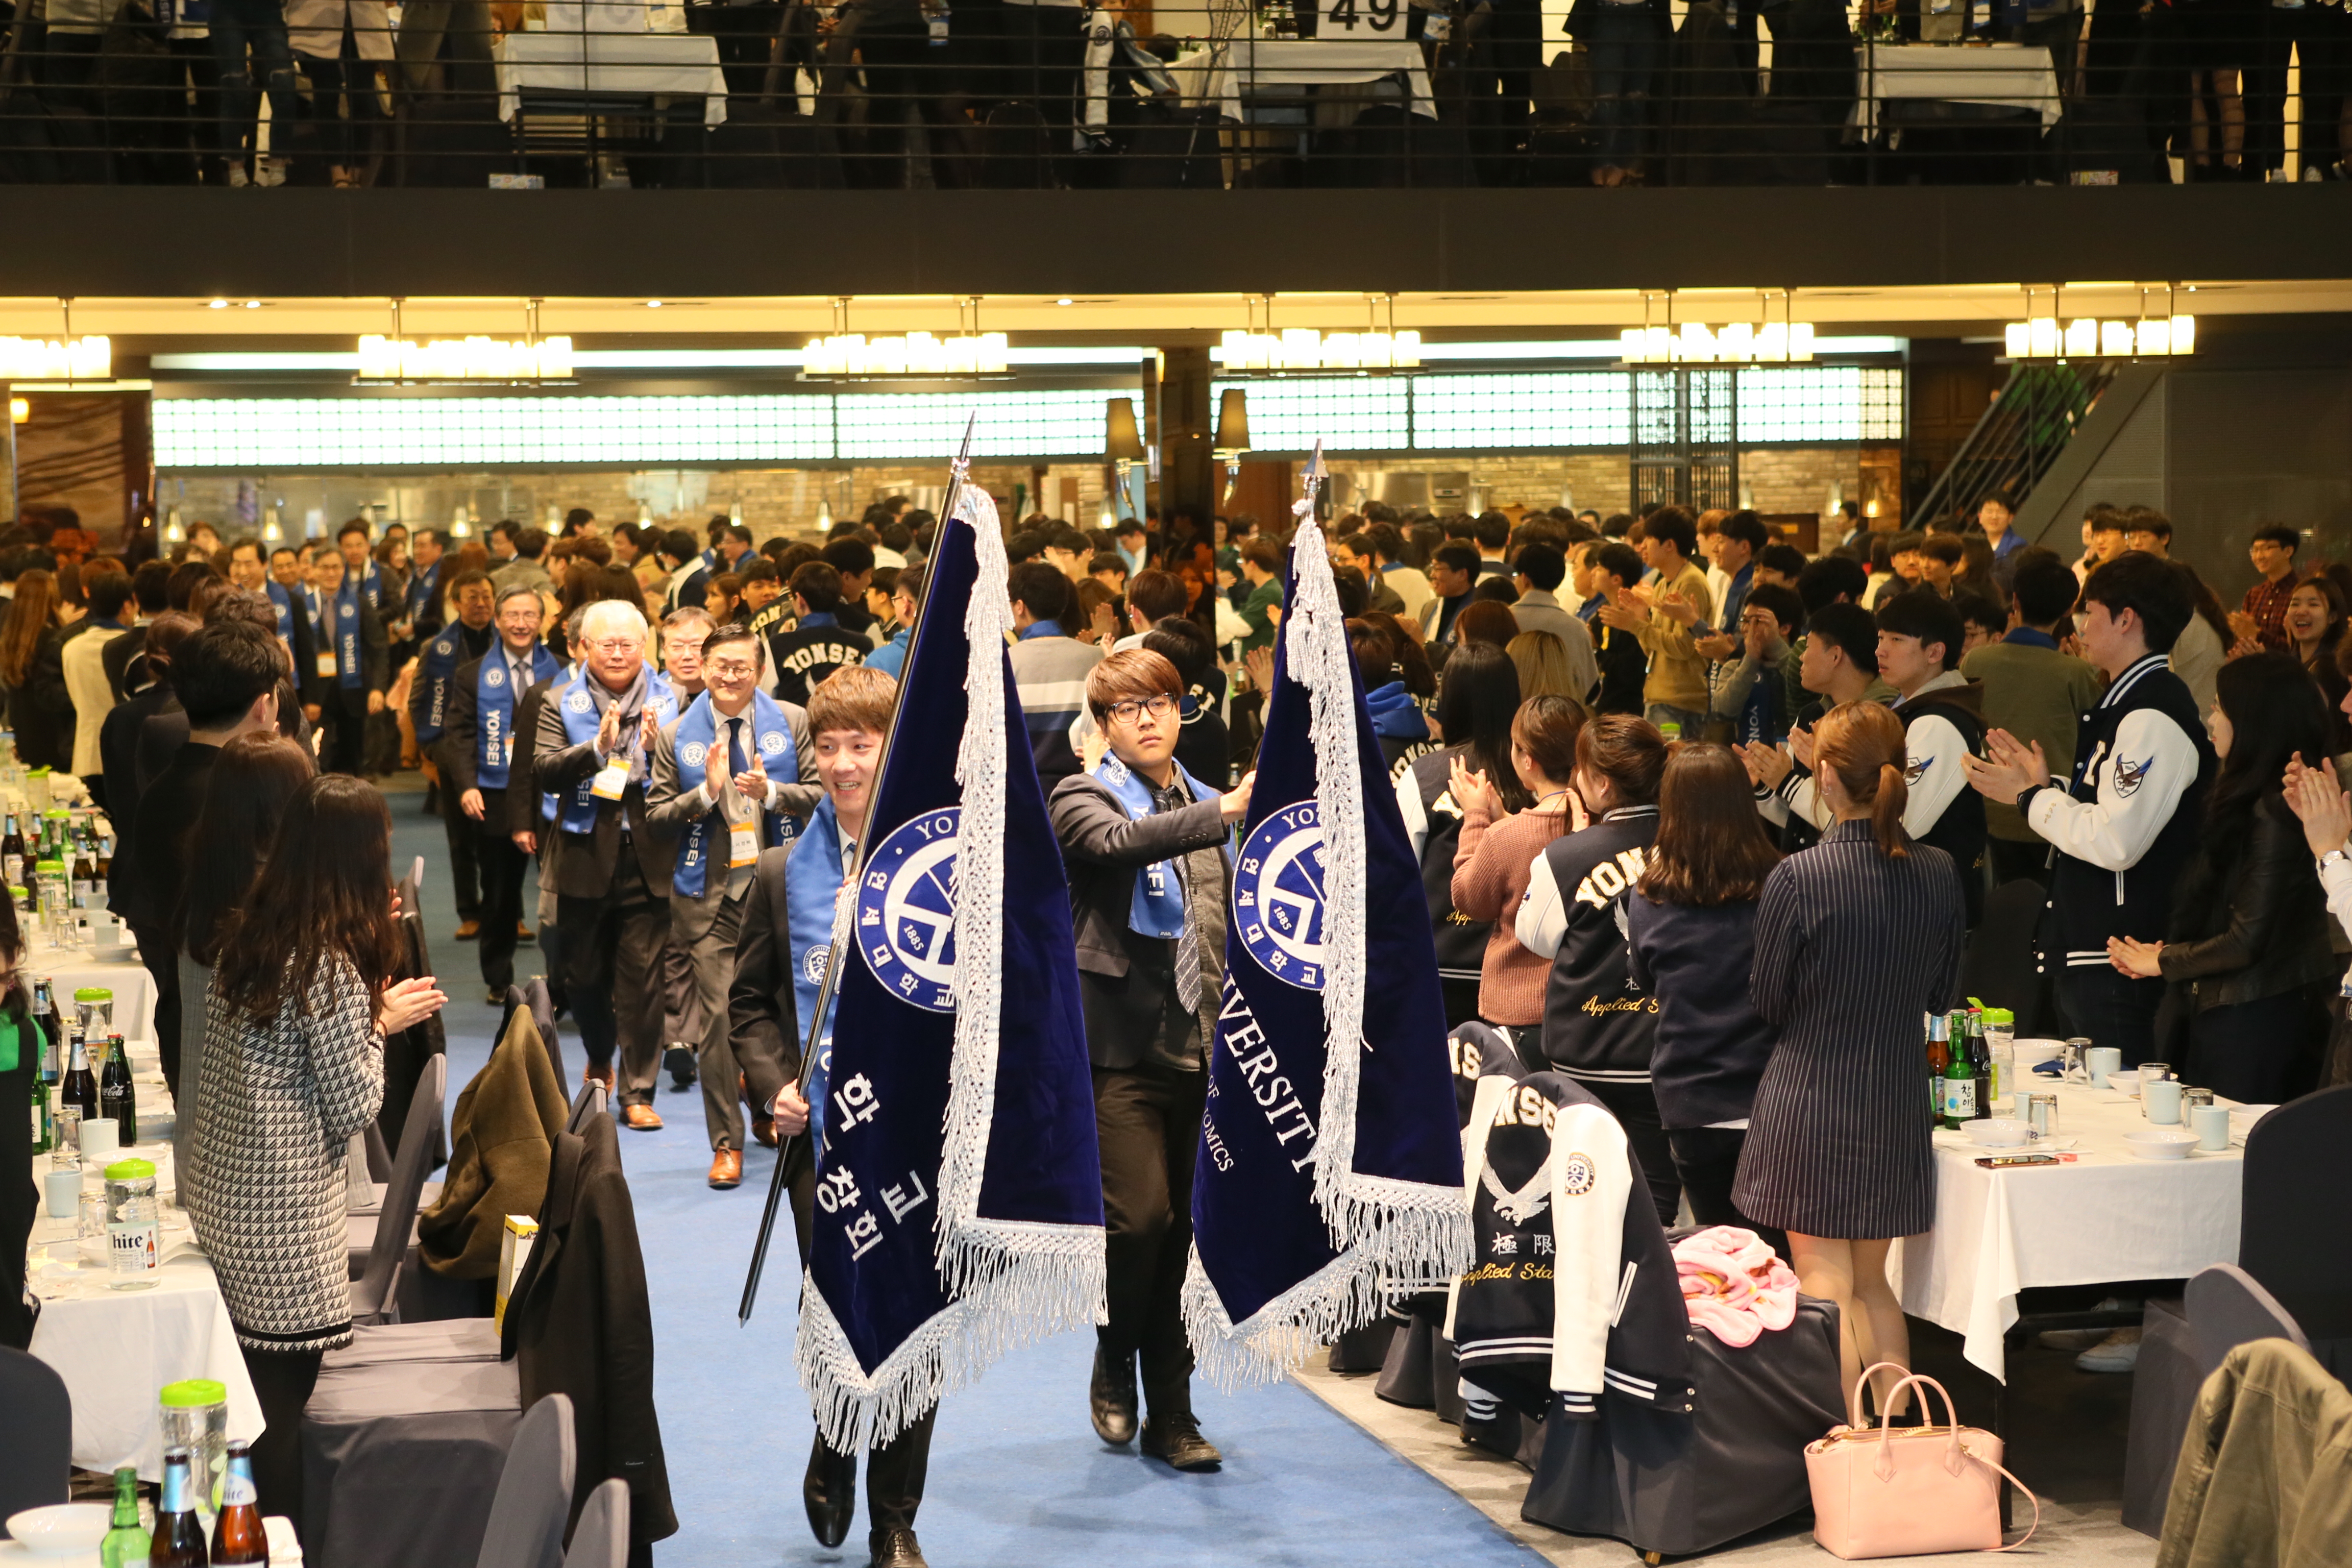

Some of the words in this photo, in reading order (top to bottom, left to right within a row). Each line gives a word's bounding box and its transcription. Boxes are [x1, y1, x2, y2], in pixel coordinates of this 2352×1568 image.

[1329, 0, 1398, 32] 49
[749, 605, 781, 633] YON
[344, 633, 356, 674] YONSEI
[430, 677, 445, 727] YONSEI
[486, 709, 501, 766] YONSEI
[577, 779, 589, 806] SEI
[684, 823, 703, 867] NSEI
[1273, 905, 1292, 930] 1885
[903, 924, 924, 951] 1885
[1581, 995, 1645, 1017] Applied
[1648, 998, 1659, 1013] S
[1218, 965, 1318, 1173] IVERSITY
[1961, 1084, 1972, 1097] 참
[1963, 1097, 1975, 1111] 이슬
[1495, 1086, 1558, 1140] NSE
[1203, 1108, 1234, 1172] OMICS
[112, 1234, 143, 1249] hite
[1491, 1231, 1556, 1256] 極限
[1461, 1262, 1516, 1286] pplied
[1520, 1262, 1554, 1281] Sta
